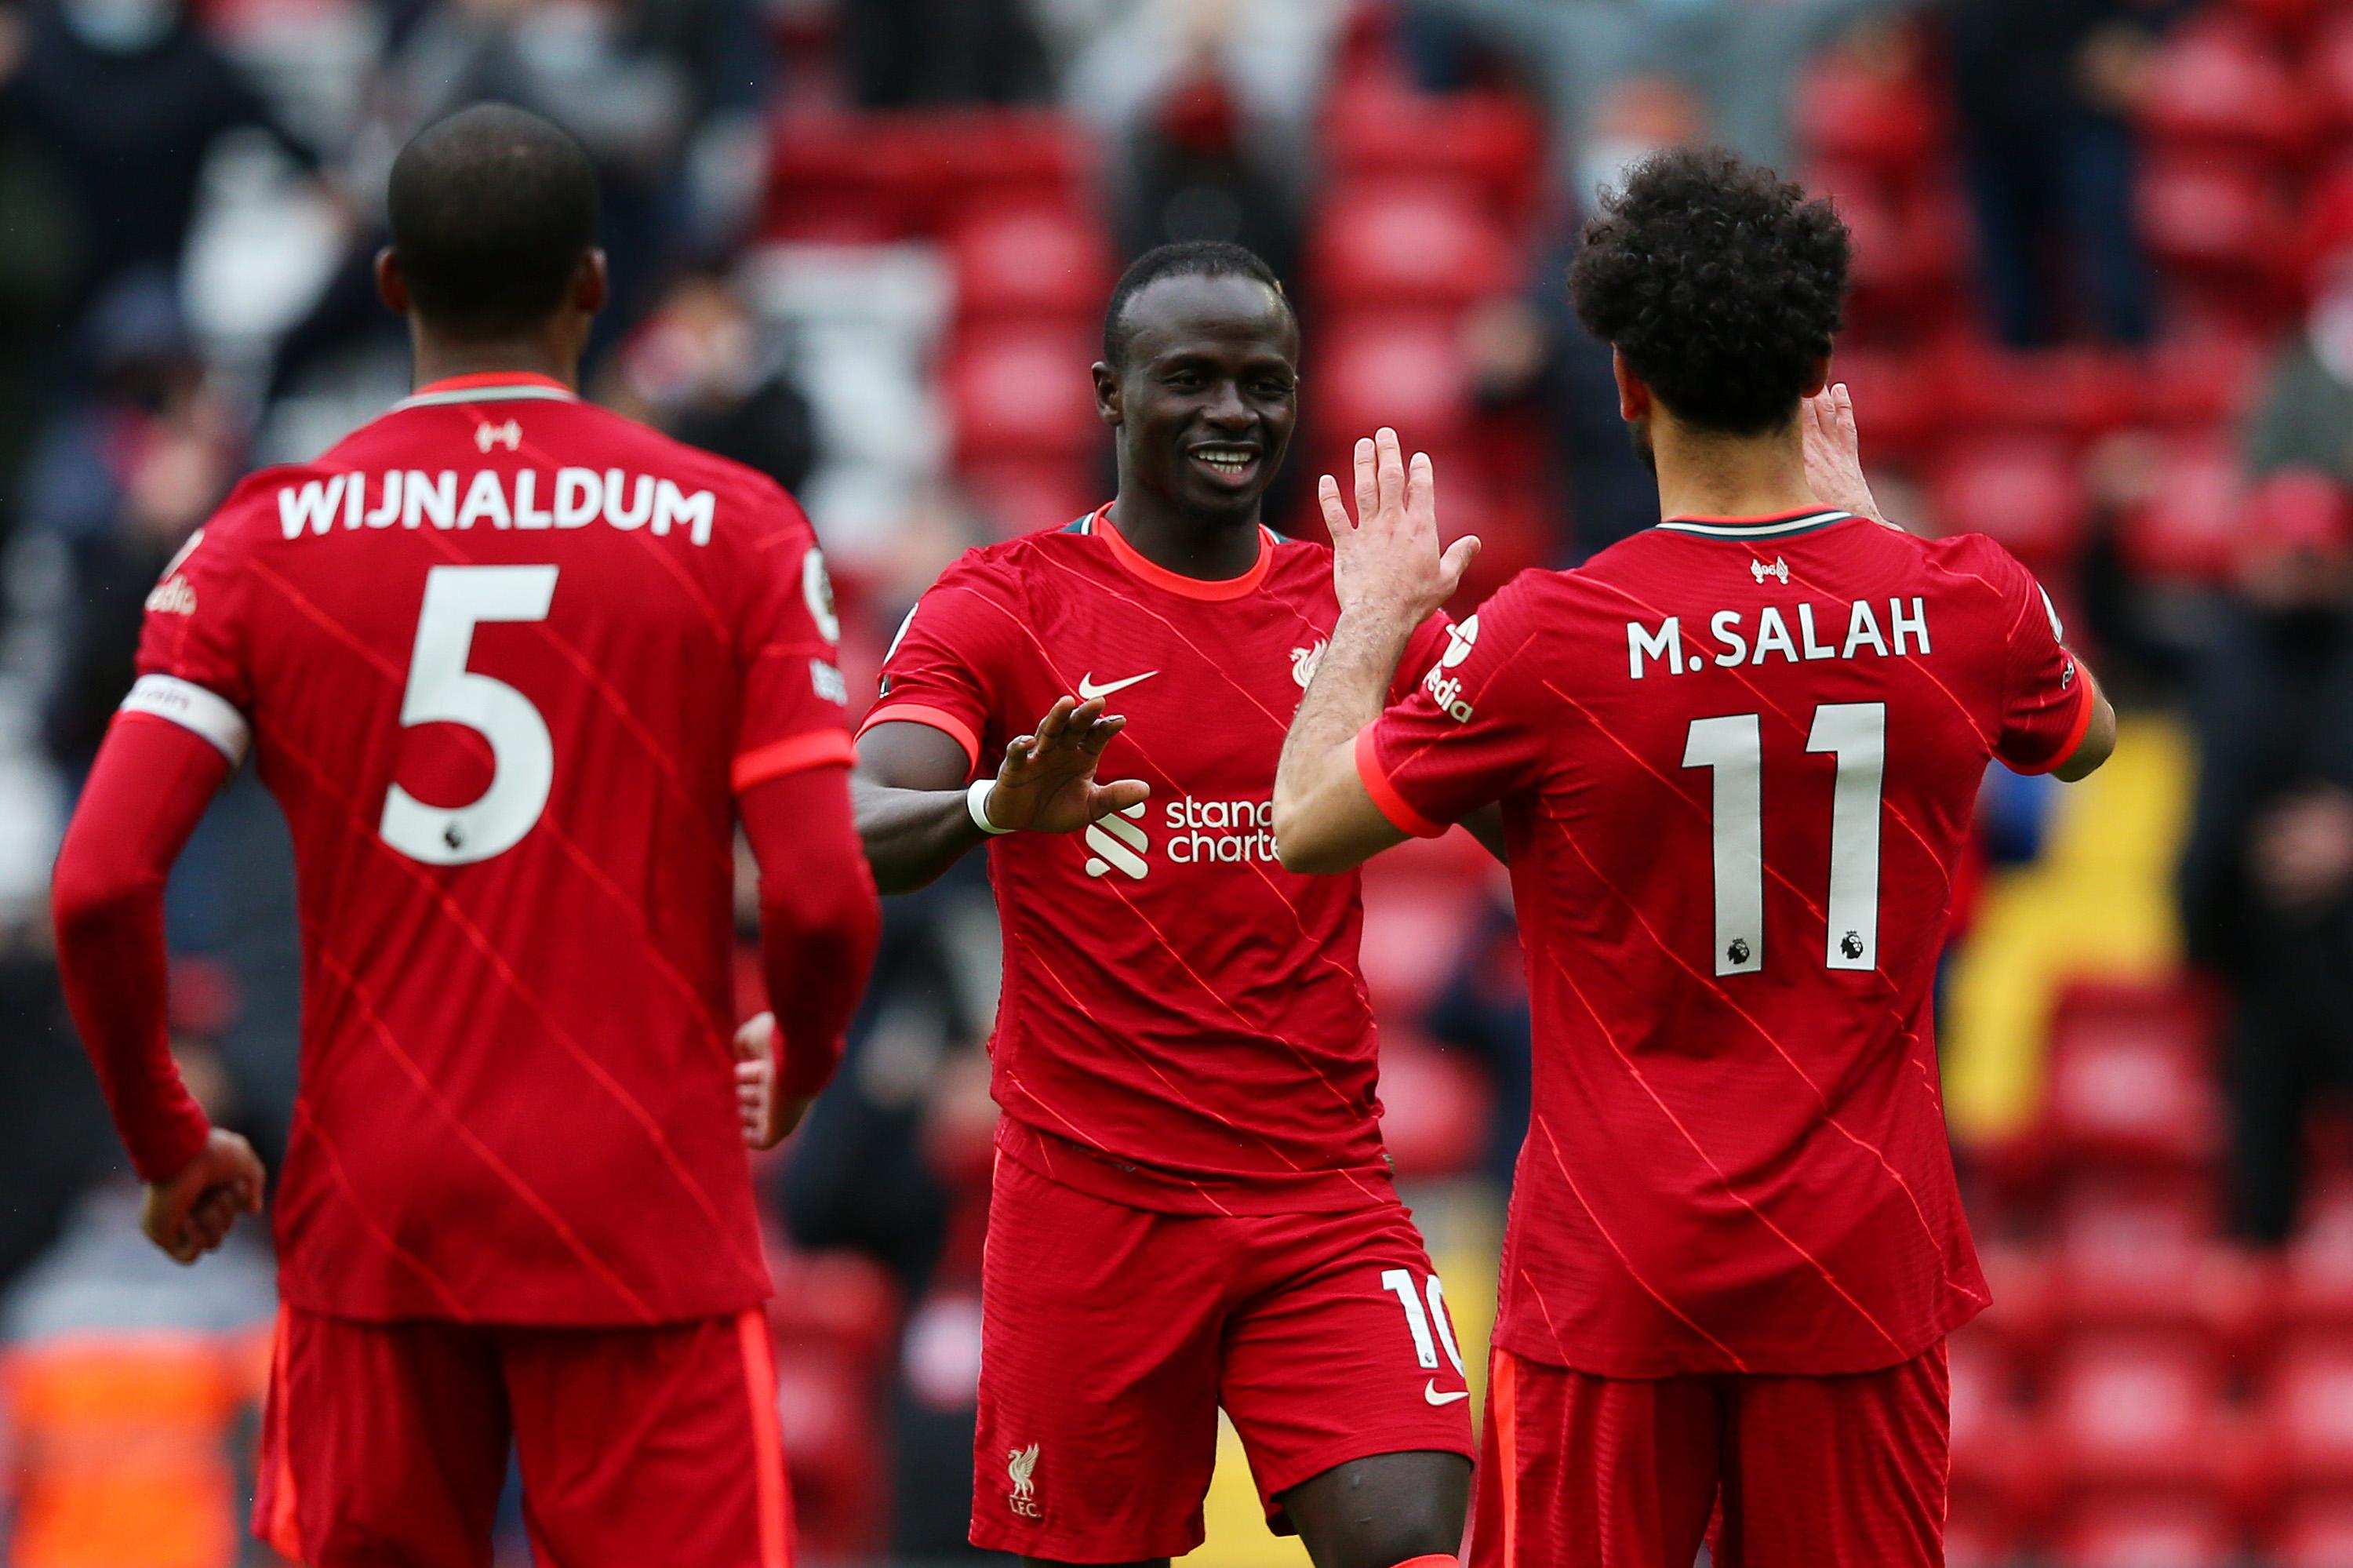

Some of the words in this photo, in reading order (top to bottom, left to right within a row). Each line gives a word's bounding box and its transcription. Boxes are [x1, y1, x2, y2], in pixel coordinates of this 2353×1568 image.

[278, 467, 715, 546] WIJNALDUM
[379, 564, 559, 866] 5
[1681, 702, 1886, 977] 11
